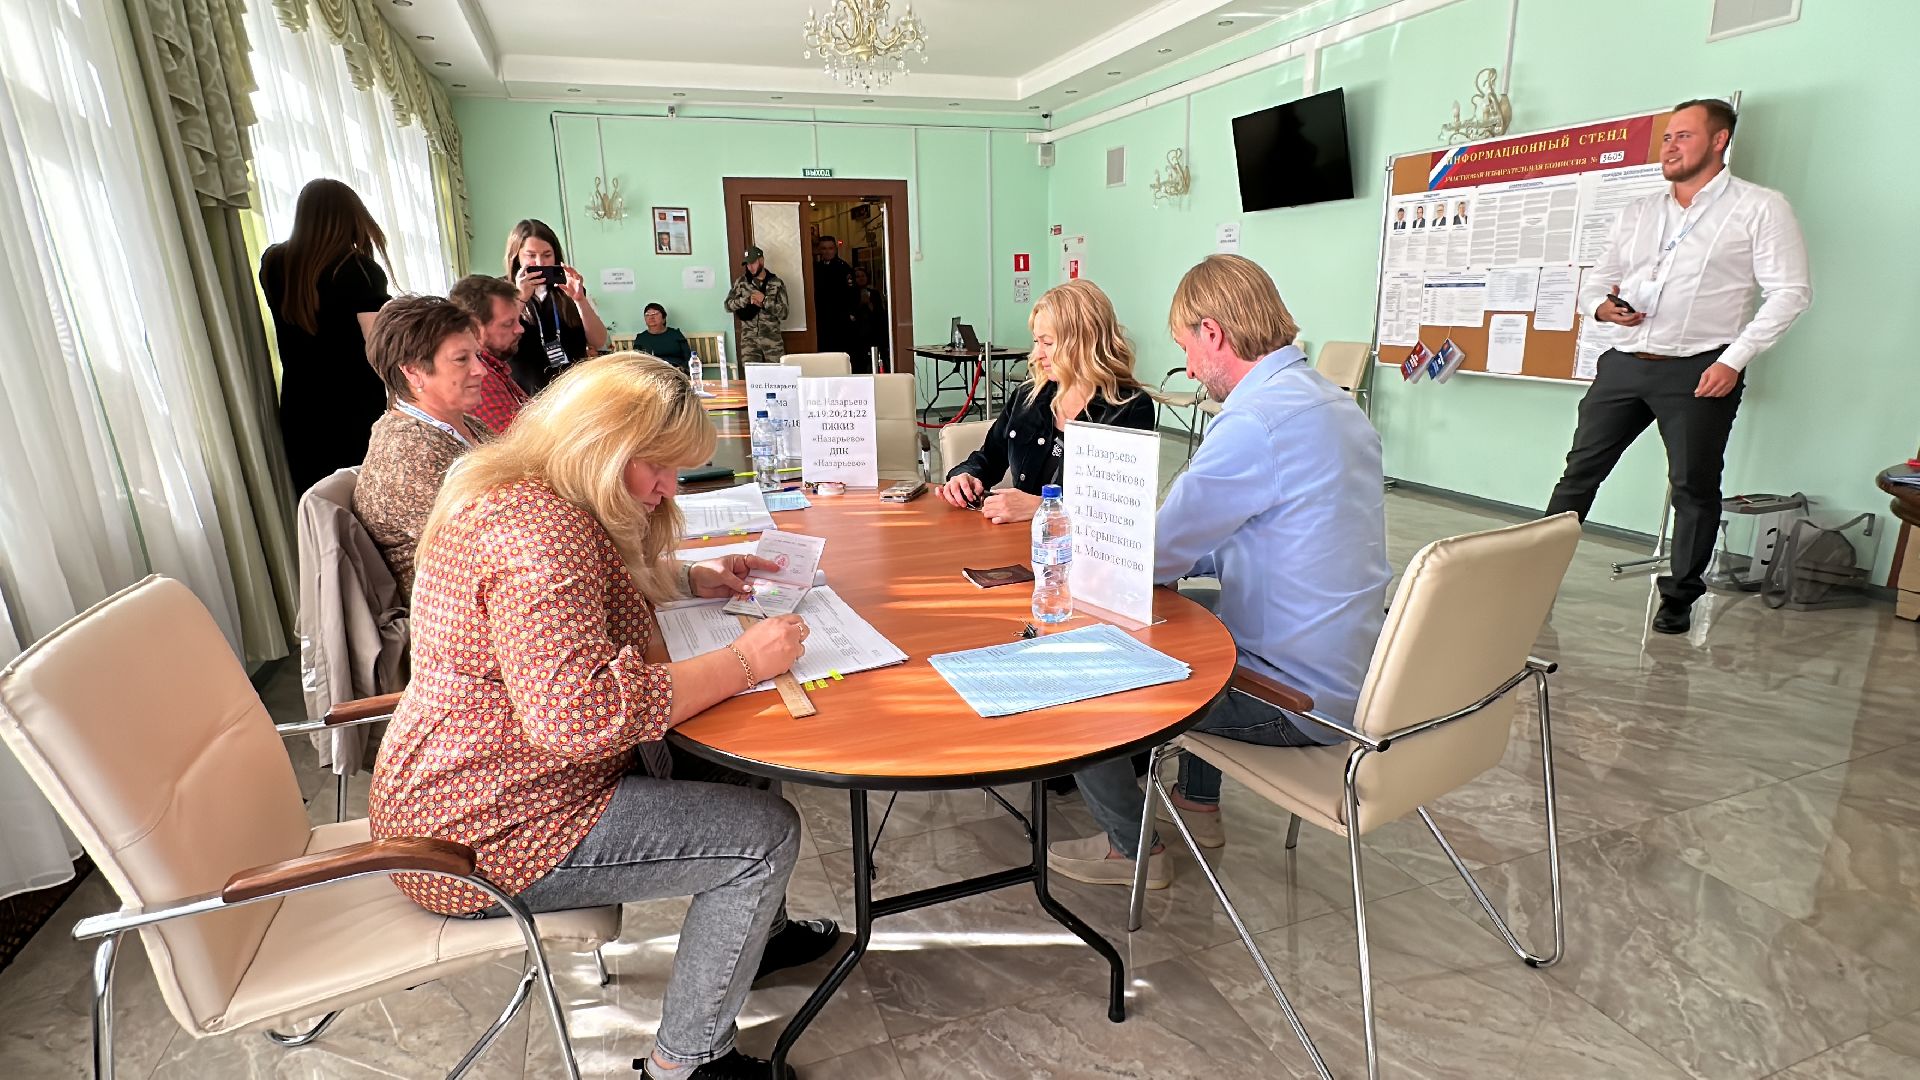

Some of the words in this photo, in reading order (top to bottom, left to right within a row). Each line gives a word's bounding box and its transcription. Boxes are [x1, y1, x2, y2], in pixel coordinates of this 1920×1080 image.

[1446, 134, 1570, 165] ИНФОРМАЦИОННЫЙ
[1579, 128, 1628, 145] СТЕНД
[1445, 171, 1484, 182] УЧАСТКОВАЯ
[1485, 163, 1543, 177] ИЗБИРАТЕЛЬНАЯ
[1602, 151, 1623, 163] 3605
[764, 382, 799, 391] Назарьев
[824, 398, 868, 406] Назарьево
[812, 435, 865, 444] «Назарьево»
[829, 447, 849, 456] ДПК
[1075, 446, 1084, 456] д.
[1087, 444, 1137, 464] Назарьево
[813, 459, 866, 469] «Назарьево»
[1086, 465, 1145, 488] Матвейково
[1075, 486, 1084, 496] д.
[1087, 485, 1141, 507] Таганьково
[1075, 506, 1083, 515] д.
[1074, 525, 1082, 535] д.
